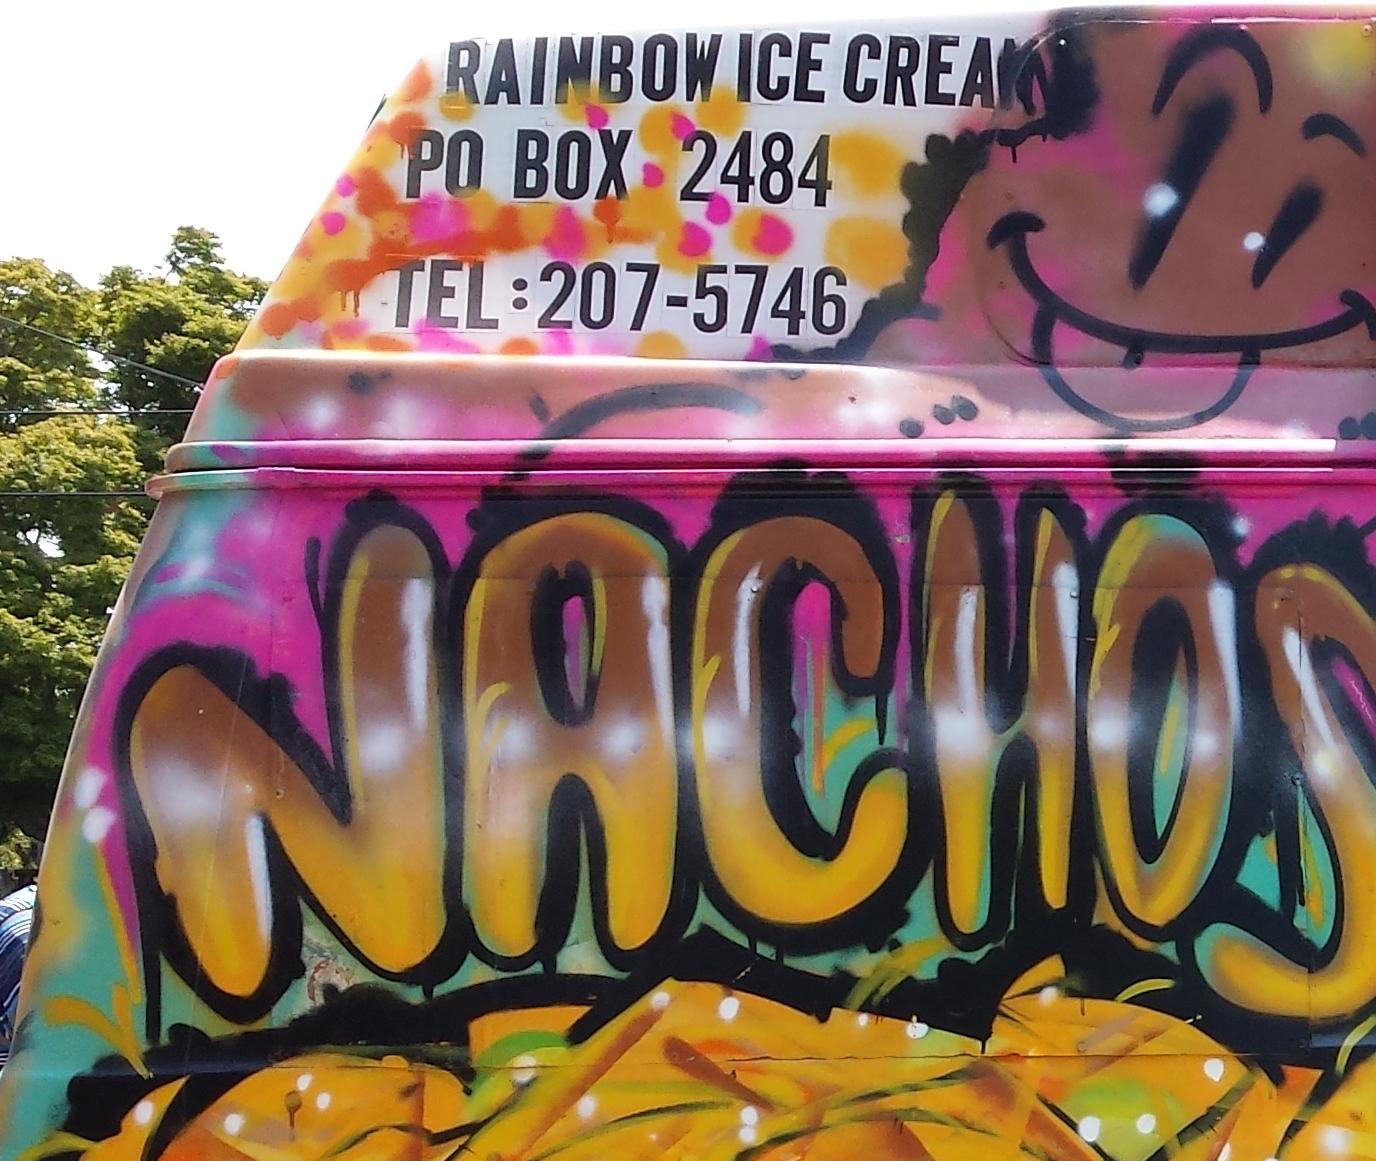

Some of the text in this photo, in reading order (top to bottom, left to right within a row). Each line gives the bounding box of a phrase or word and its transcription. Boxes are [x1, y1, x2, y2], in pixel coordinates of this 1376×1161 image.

[446, 32, 723, 105] RAINBOW
[737, 32, 831, 103] ICE
[405, 128, 833, 208] PO BOX 2484
